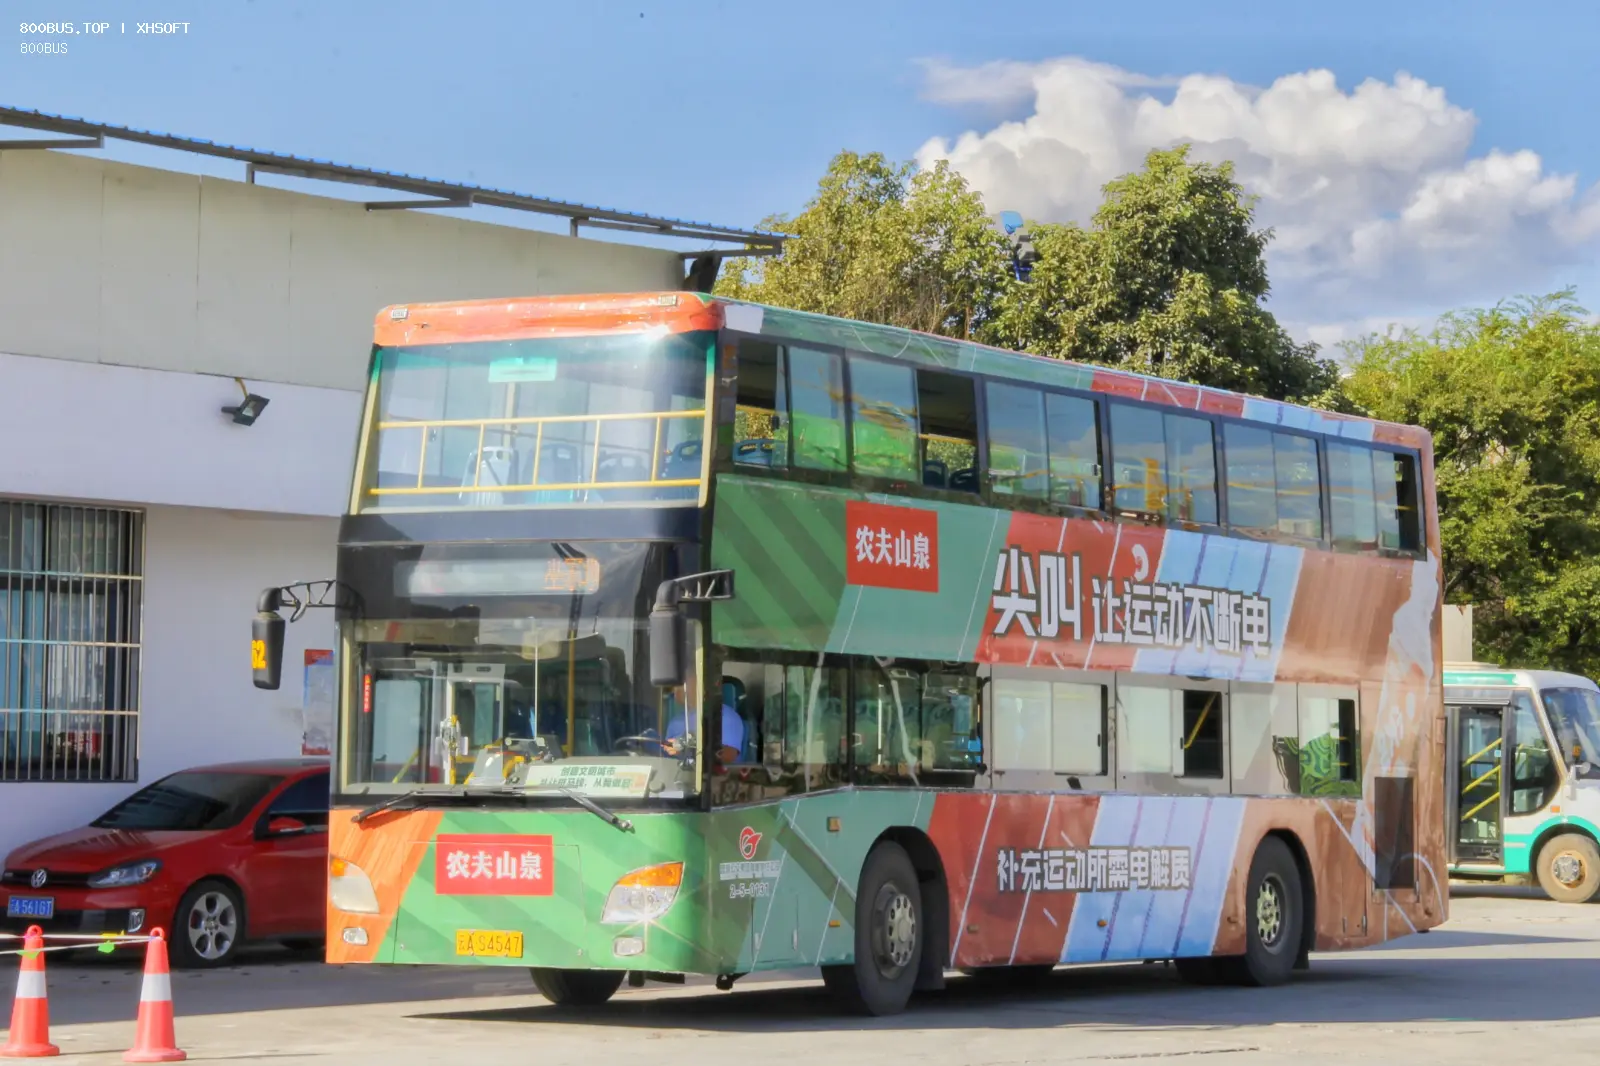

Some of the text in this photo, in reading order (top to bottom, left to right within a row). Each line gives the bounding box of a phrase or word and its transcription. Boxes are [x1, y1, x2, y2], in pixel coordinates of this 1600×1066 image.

[854, 525, 931, 570] 农夫山泉
[992, 545, 1272, 658] 尖叫 让运动不断电
[446, 851, 543, 880] 农夫山泉
[996, 849, 1191, 891] 补充运动所需电解质
